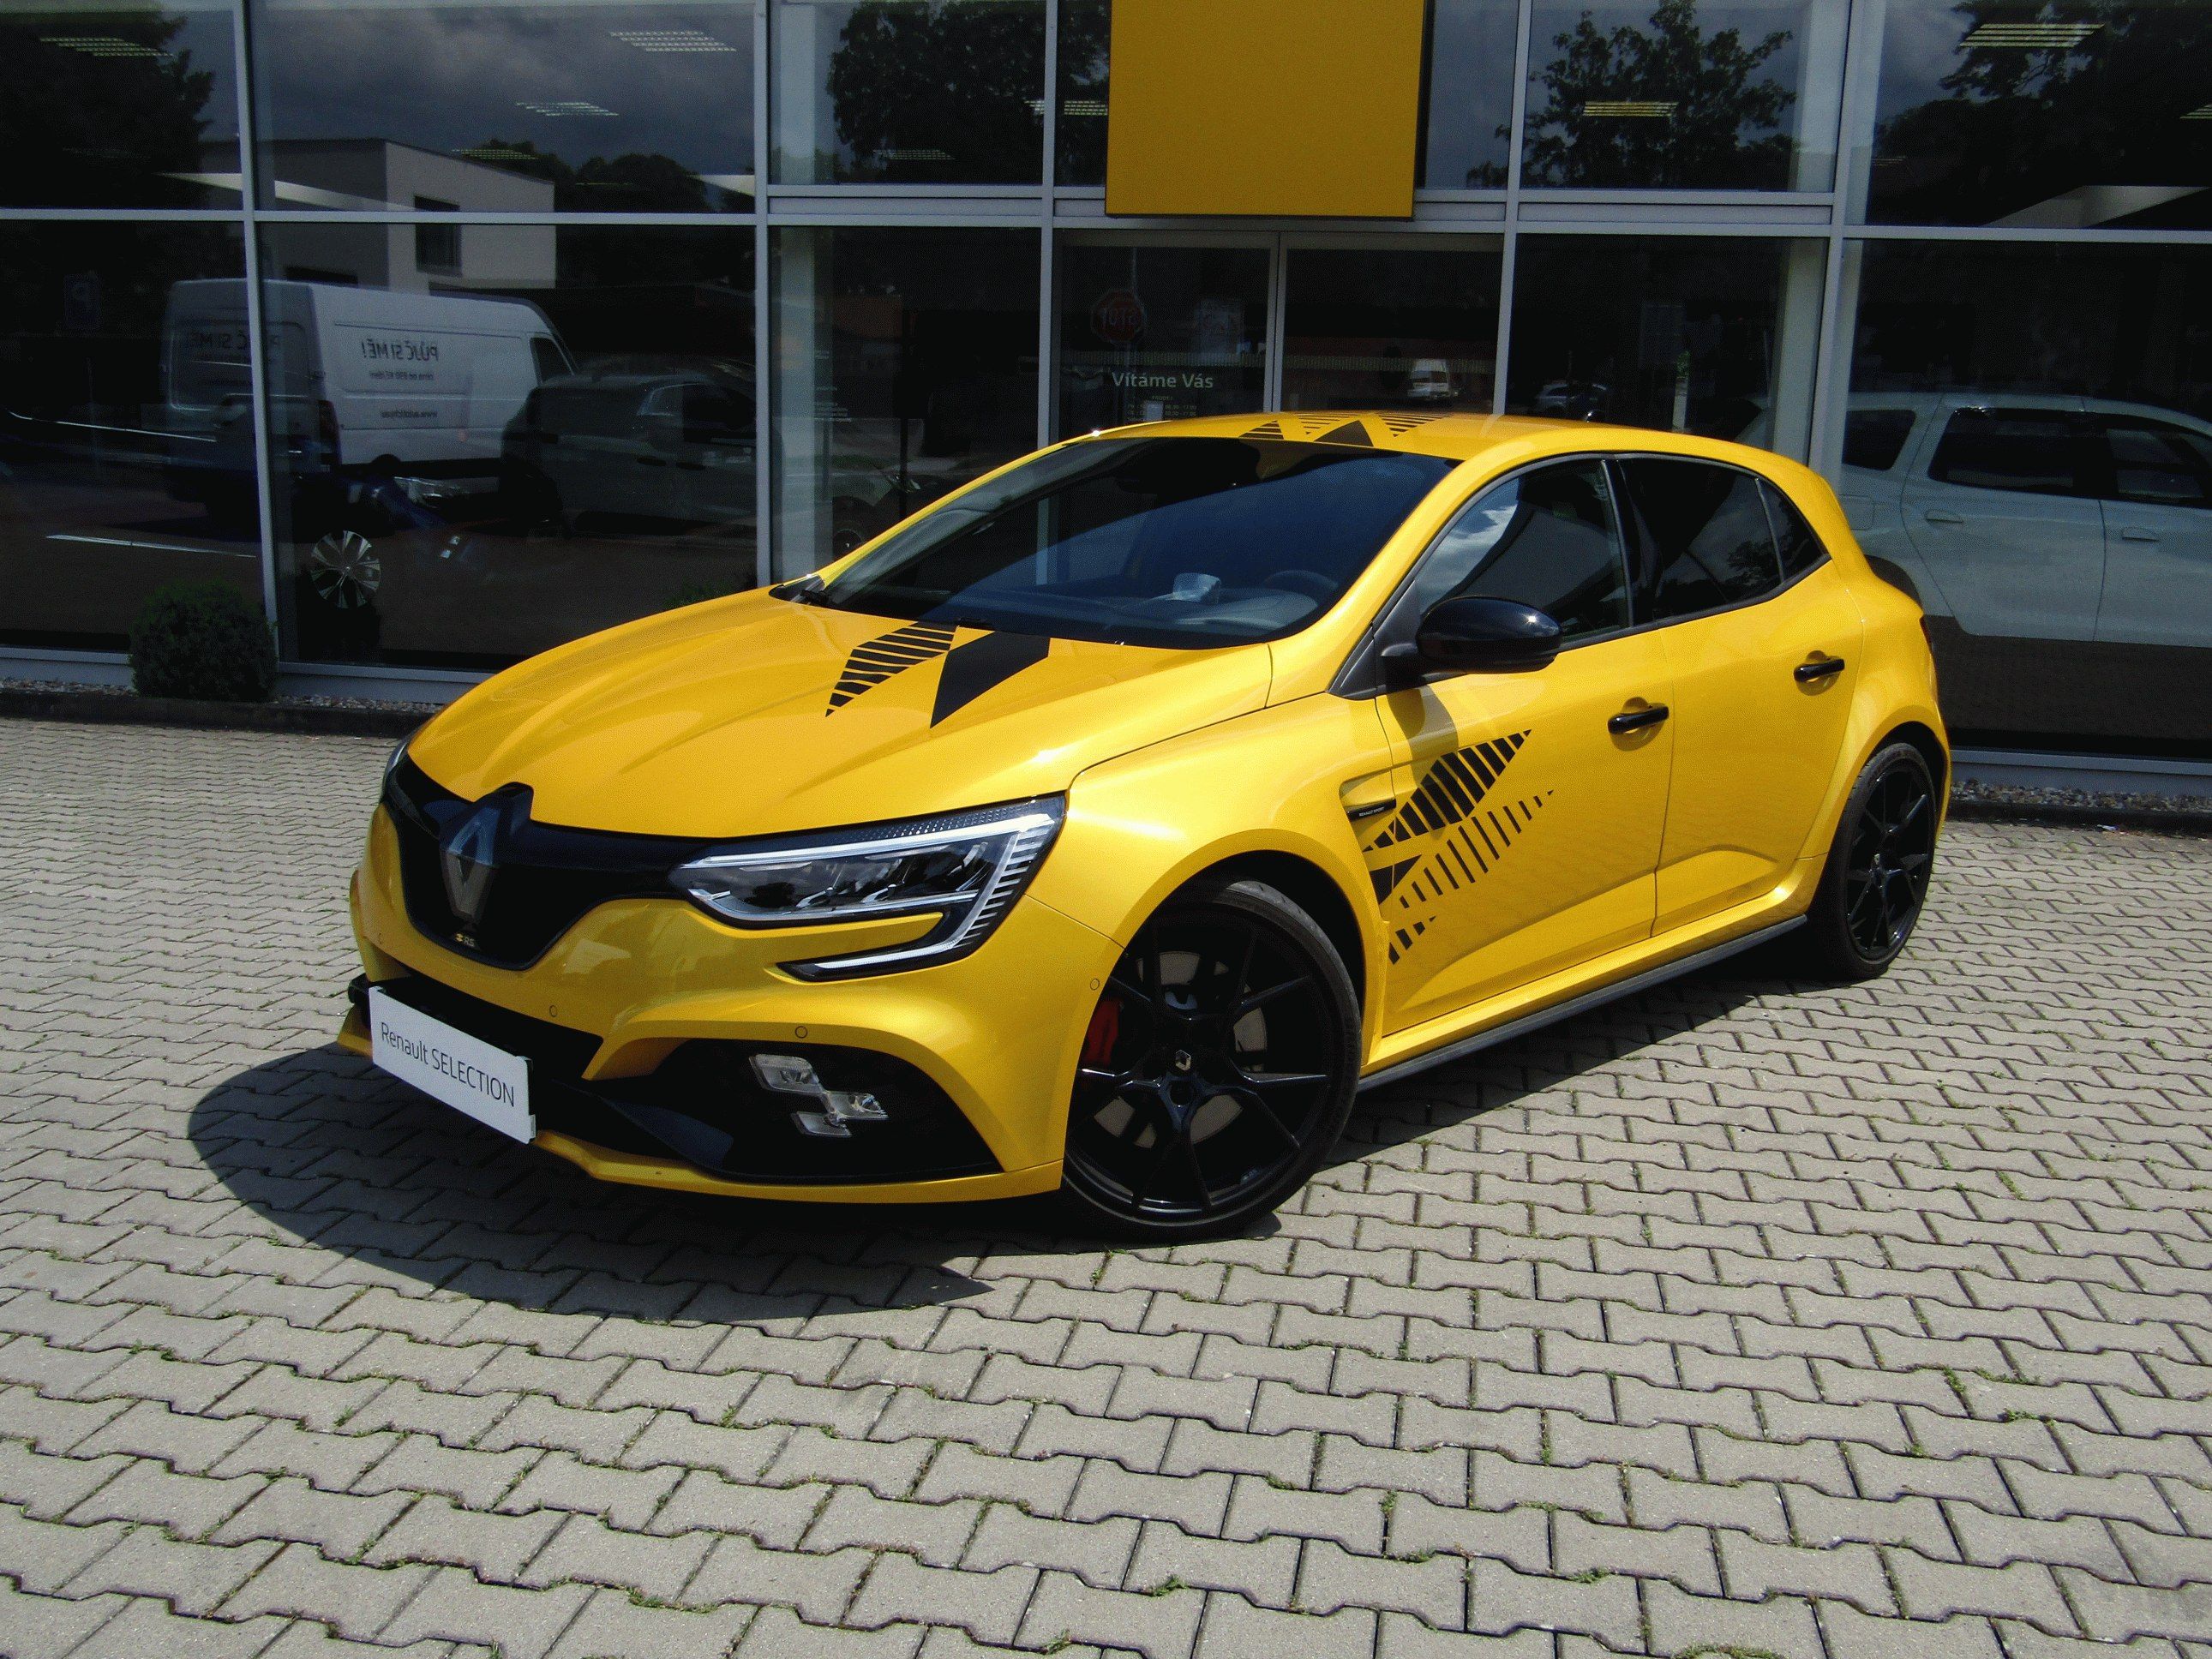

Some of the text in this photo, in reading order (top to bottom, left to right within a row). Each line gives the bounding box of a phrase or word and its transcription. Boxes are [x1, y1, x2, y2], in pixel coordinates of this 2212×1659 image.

[1112, 372, 1214, 389] Vítáme Vás
[464, 936, 475, 948] RS
[381, 1022, 514, 1107] Renault SELECTION
